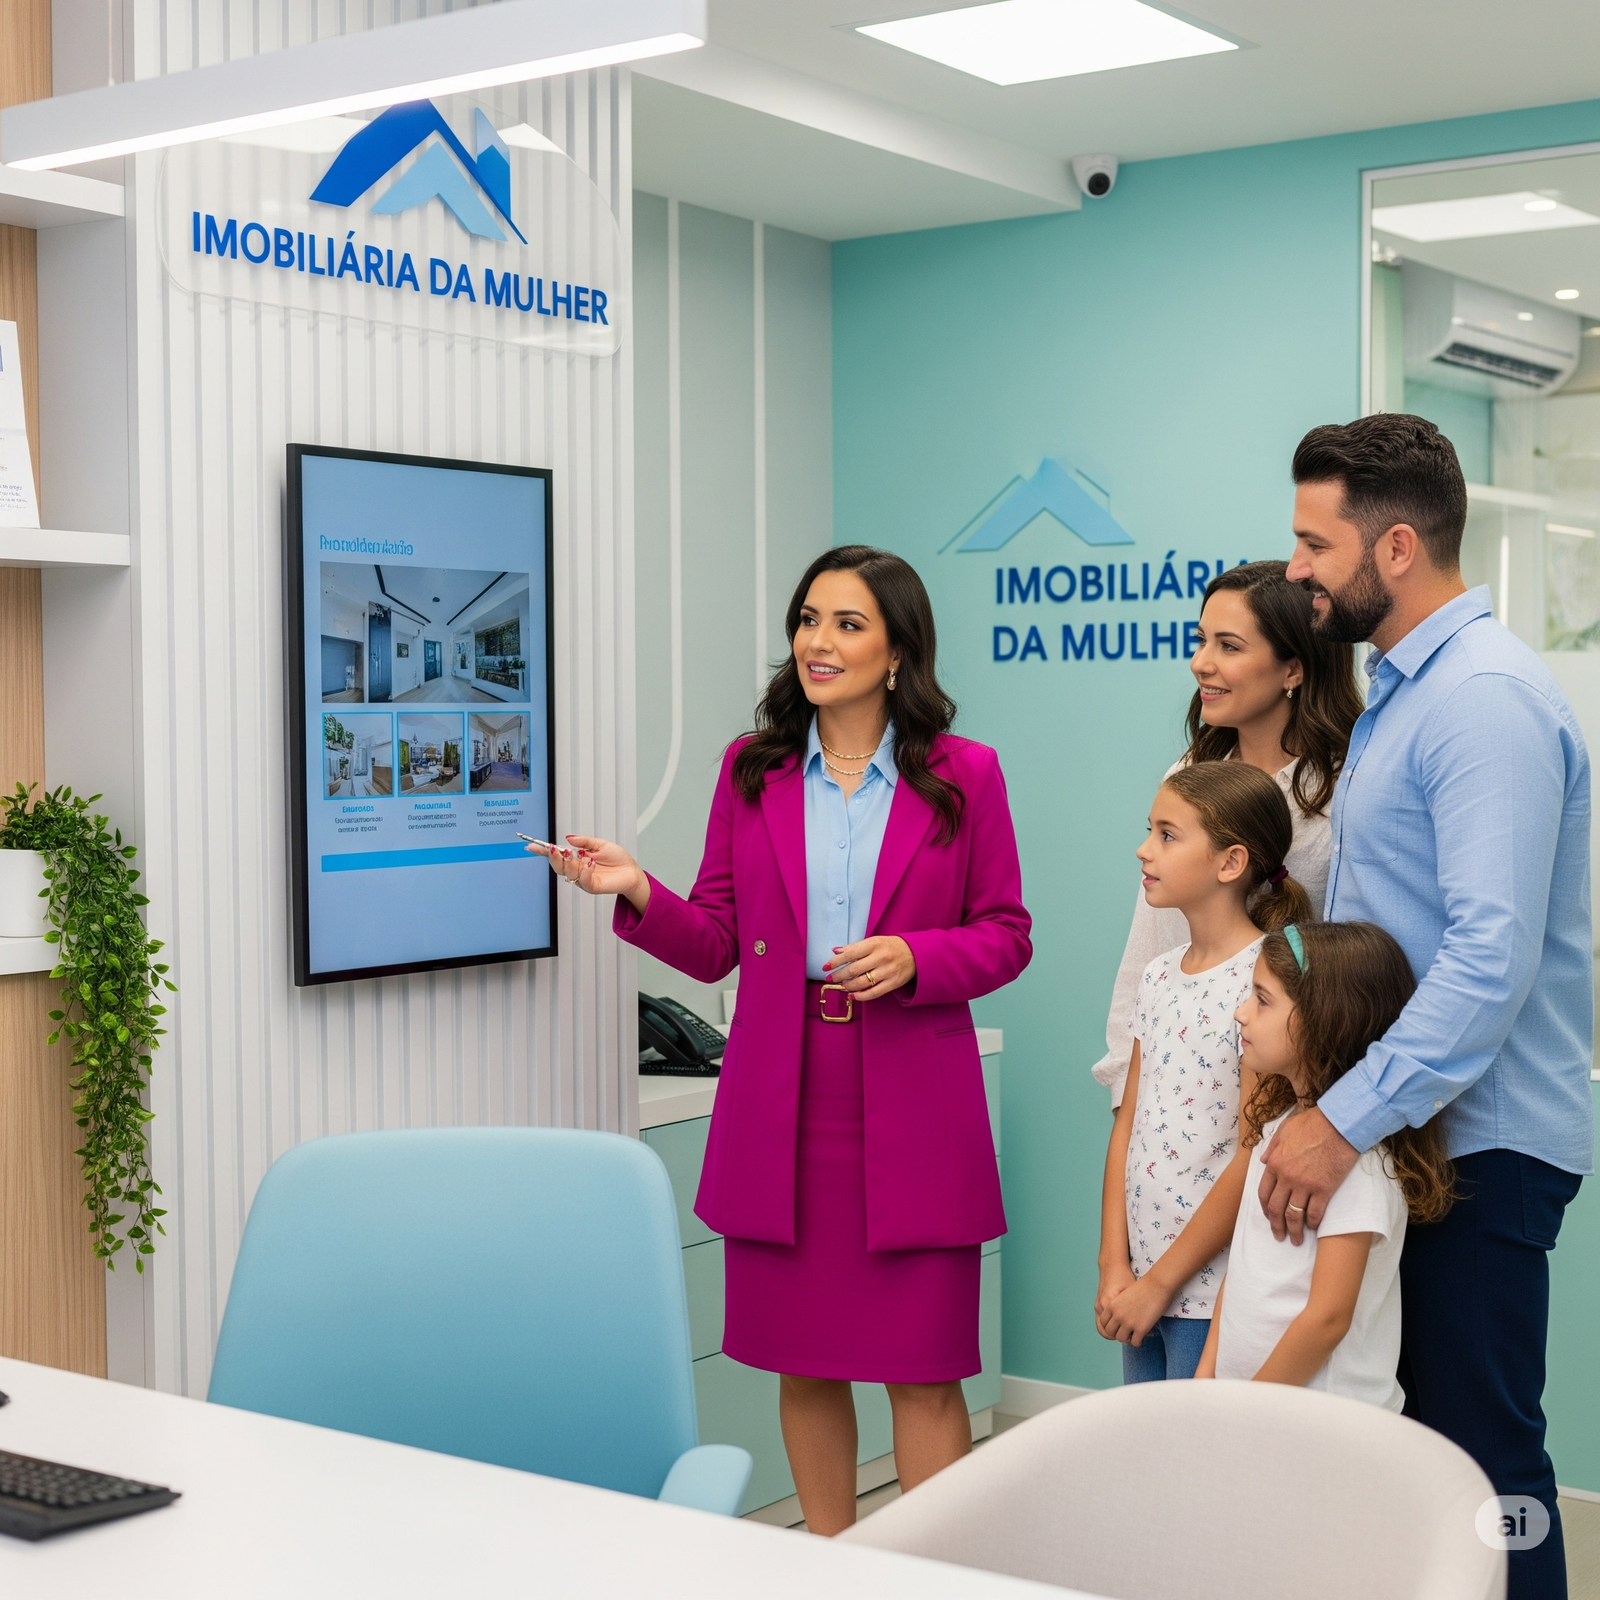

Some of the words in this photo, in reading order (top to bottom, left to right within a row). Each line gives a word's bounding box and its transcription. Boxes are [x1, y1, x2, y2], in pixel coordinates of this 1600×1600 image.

[192, 211, 420, 292] IMOBILIÁRIA
[429, 257, 476, 303] DA
[484, 268, 609, 326] MULHER
[995, 549, 1249, 605] IMOBILIÁR
[992, 624, 1048, 662] DA
[1061, 620, 1202, 661] MULHE
